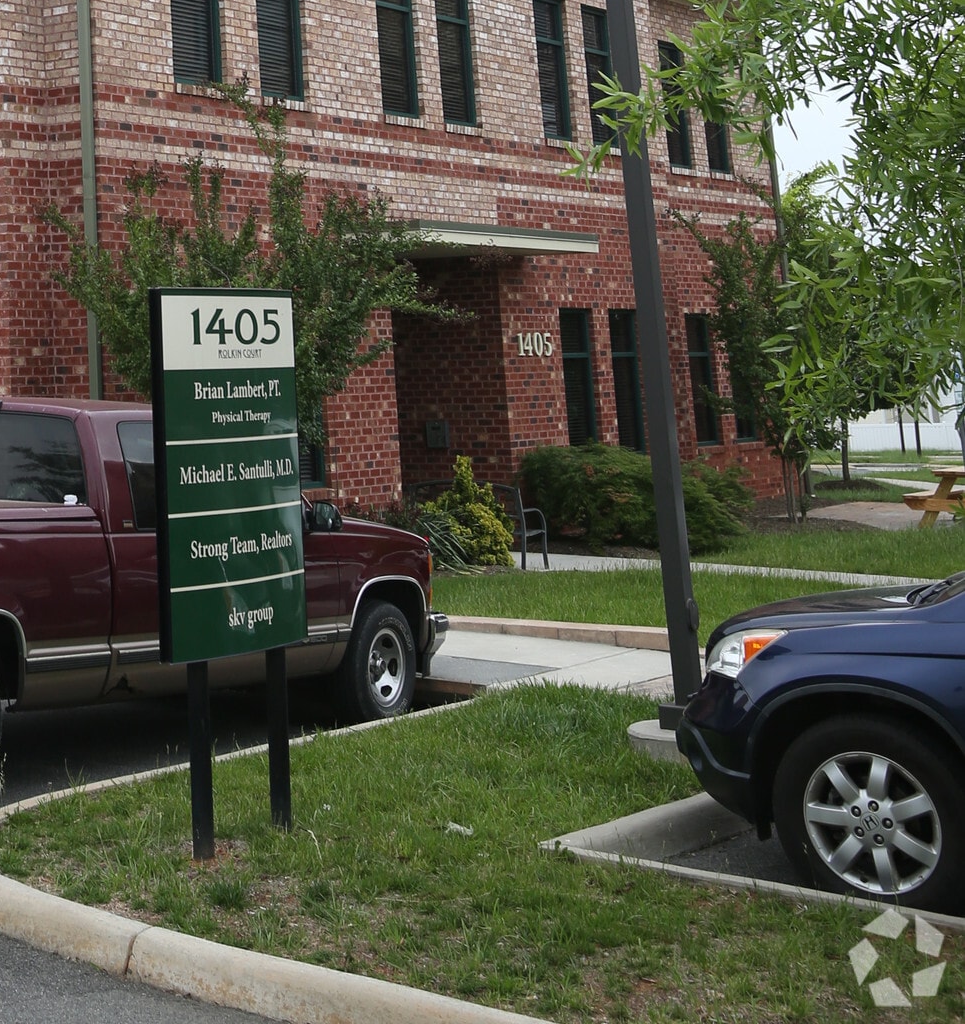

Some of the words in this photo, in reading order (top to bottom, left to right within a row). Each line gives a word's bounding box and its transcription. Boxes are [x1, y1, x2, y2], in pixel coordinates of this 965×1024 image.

[191, 308, 281, 345] 1405
[243, 348, 262, 358] COURT
[517, 332, 553, 357] 1405
[194, 382, 225, 400] Brian
[227, 380, 268, 400] Lambert,
[212, 411, 244, 425] Physical
[245, 410, 271, 423] Therapy
[180, 463, 225, 485] Michael
[227, 465, 237, 481] E.
[239, 460, 275, 480] Santulli,
[276, 458, 294, 476] M.D.
[190, 540, 229, 561] Strong
[230, 536, 260, 554] Team,
[261, 530, 293, 551] Realtors
[247, 606, 274, 629] group
